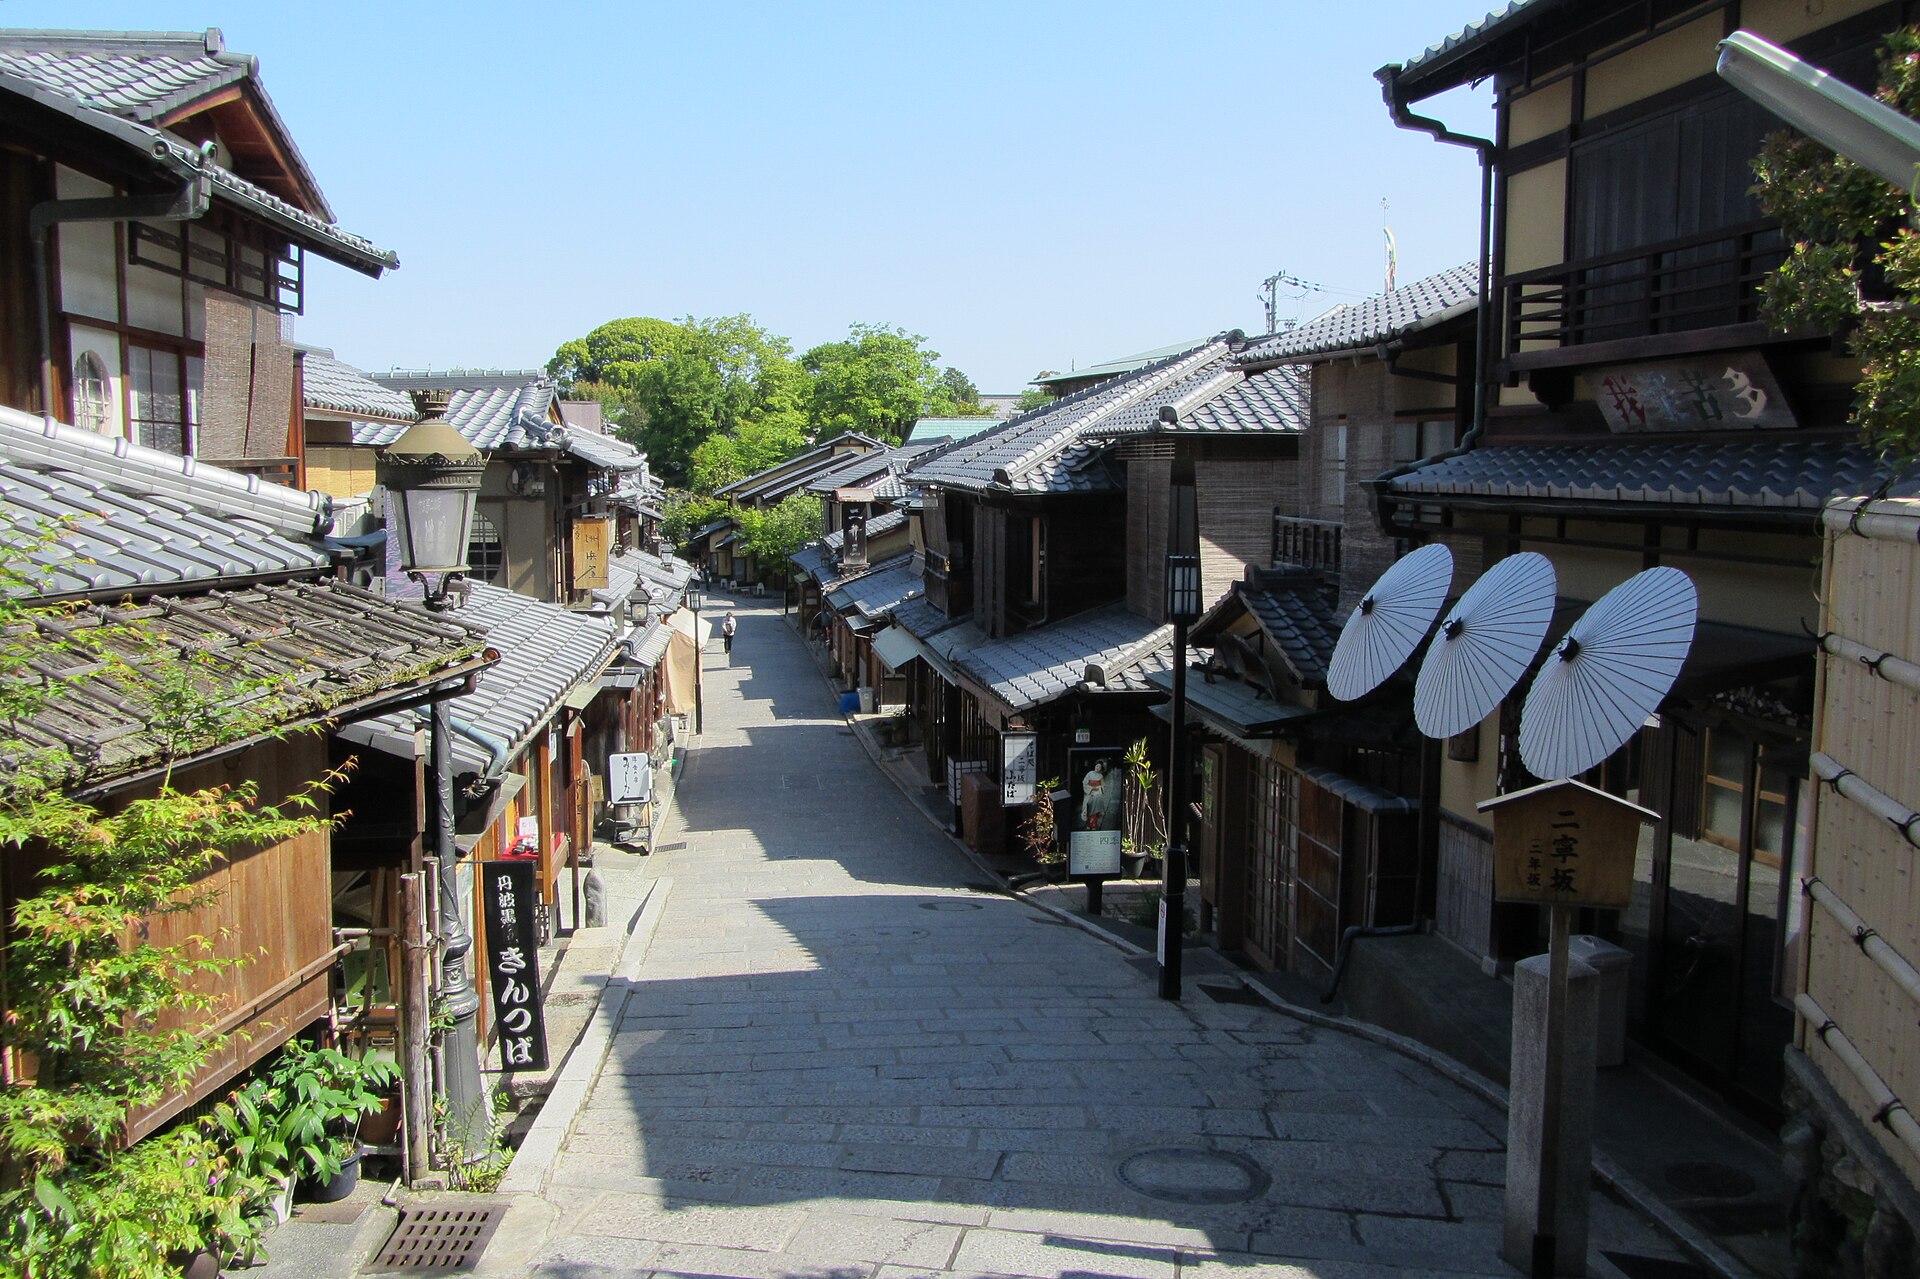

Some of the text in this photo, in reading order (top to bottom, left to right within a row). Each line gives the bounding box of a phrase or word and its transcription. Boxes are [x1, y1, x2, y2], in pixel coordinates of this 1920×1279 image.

[1006, 770, 1018, 798] ふたば
[1550, 809, 1580, 894] 二寧坂
[498, 946, 533, 1065] きんつば
